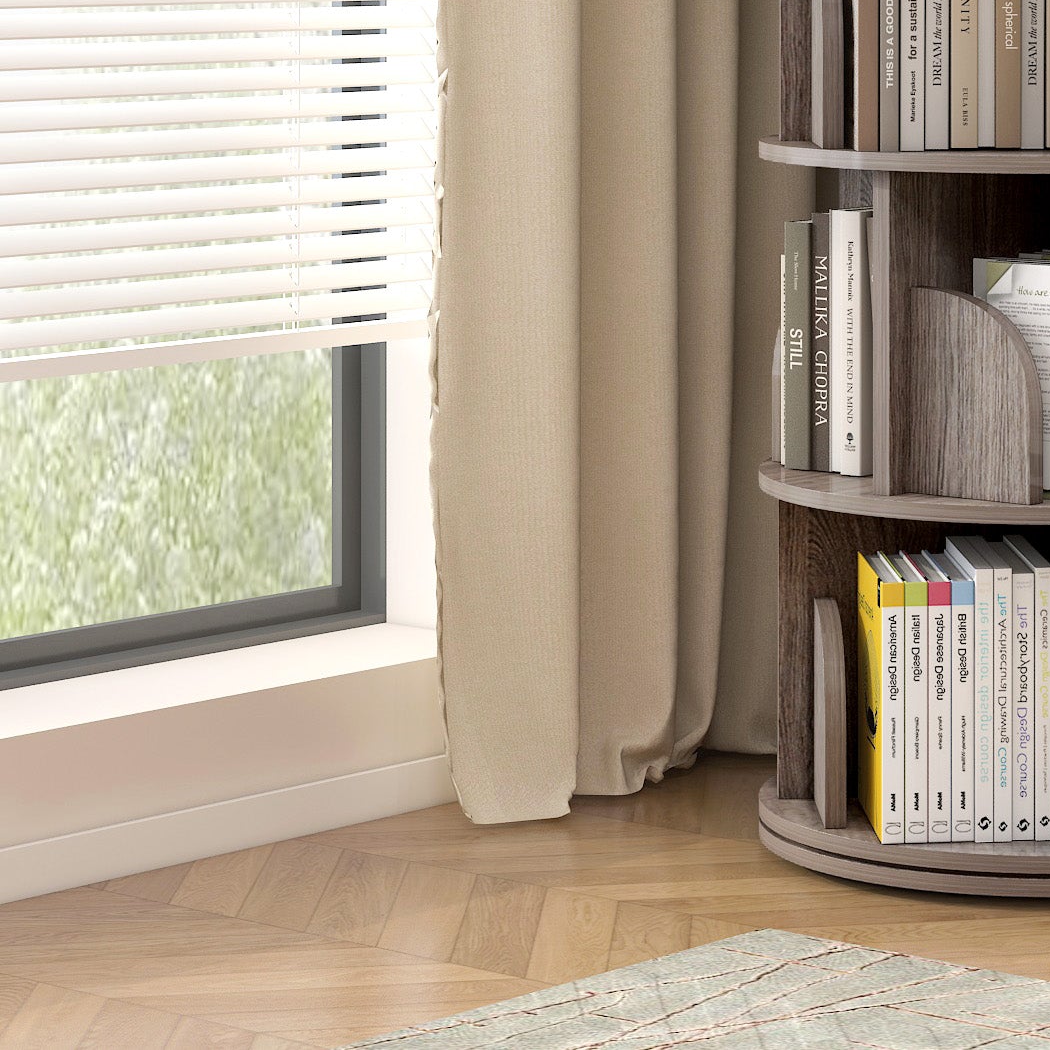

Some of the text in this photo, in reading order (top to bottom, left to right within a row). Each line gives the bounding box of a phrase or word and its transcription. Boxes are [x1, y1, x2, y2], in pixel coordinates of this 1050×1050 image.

[886, 0, 894, 35] GOOD
[934, 2, 943, 25] world
[1002, 2, 1018, 50] spherical
[1029, 2, 1038, 25] world
[934, 26, 943, 39] the
[1029, 26, 1038, 39] the
[886, 49, 894, 60] IS
[908, 43, 918, 60] for
[932, 41, 942, 86] DREAM
[1027, 41, 1037, 86] DREAM
[886, 61, 894, 88] THIS
[846, 241, 854, 301] Kathryn Mannix
[789, 328, 803, 370] STILL
[814, 255, 828, 426] MALLIKA CHOPRA
[846, 308, 854, 424] WITH THE END IN MIND
